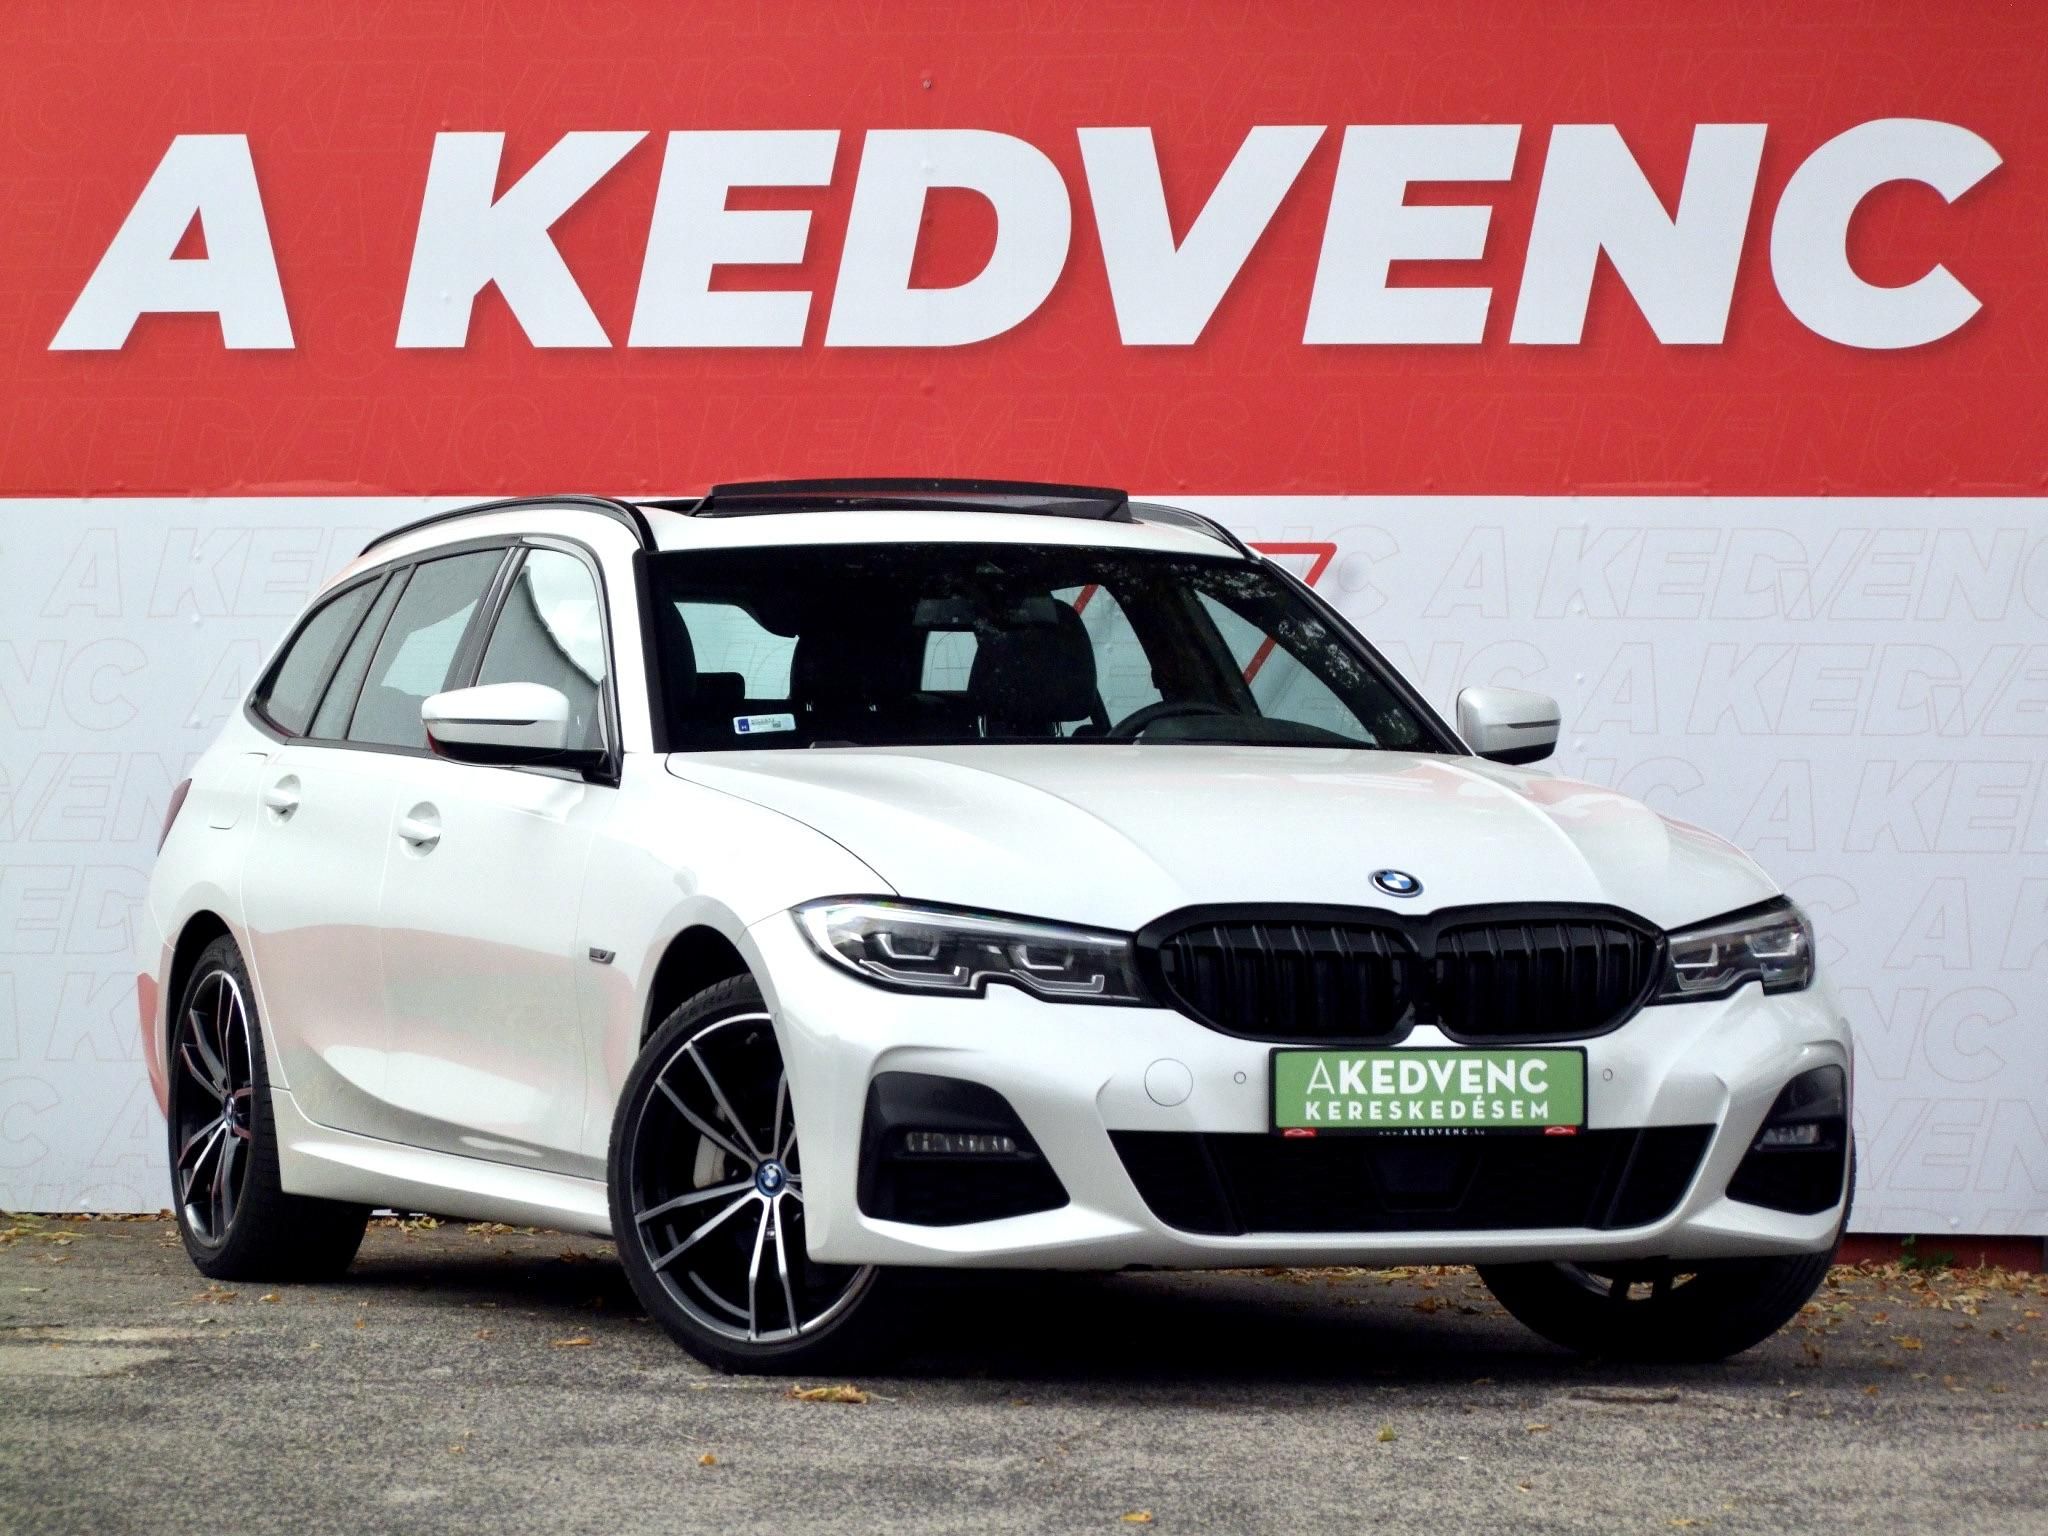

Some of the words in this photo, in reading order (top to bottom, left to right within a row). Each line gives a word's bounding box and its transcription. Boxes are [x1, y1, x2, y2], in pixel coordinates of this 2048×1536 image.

[47, 133, 296, 351] A
[394, 118, 2003, 350] KEDVENC
[1305, 1096, 1549, 1121] KERESKEDÉSEM
